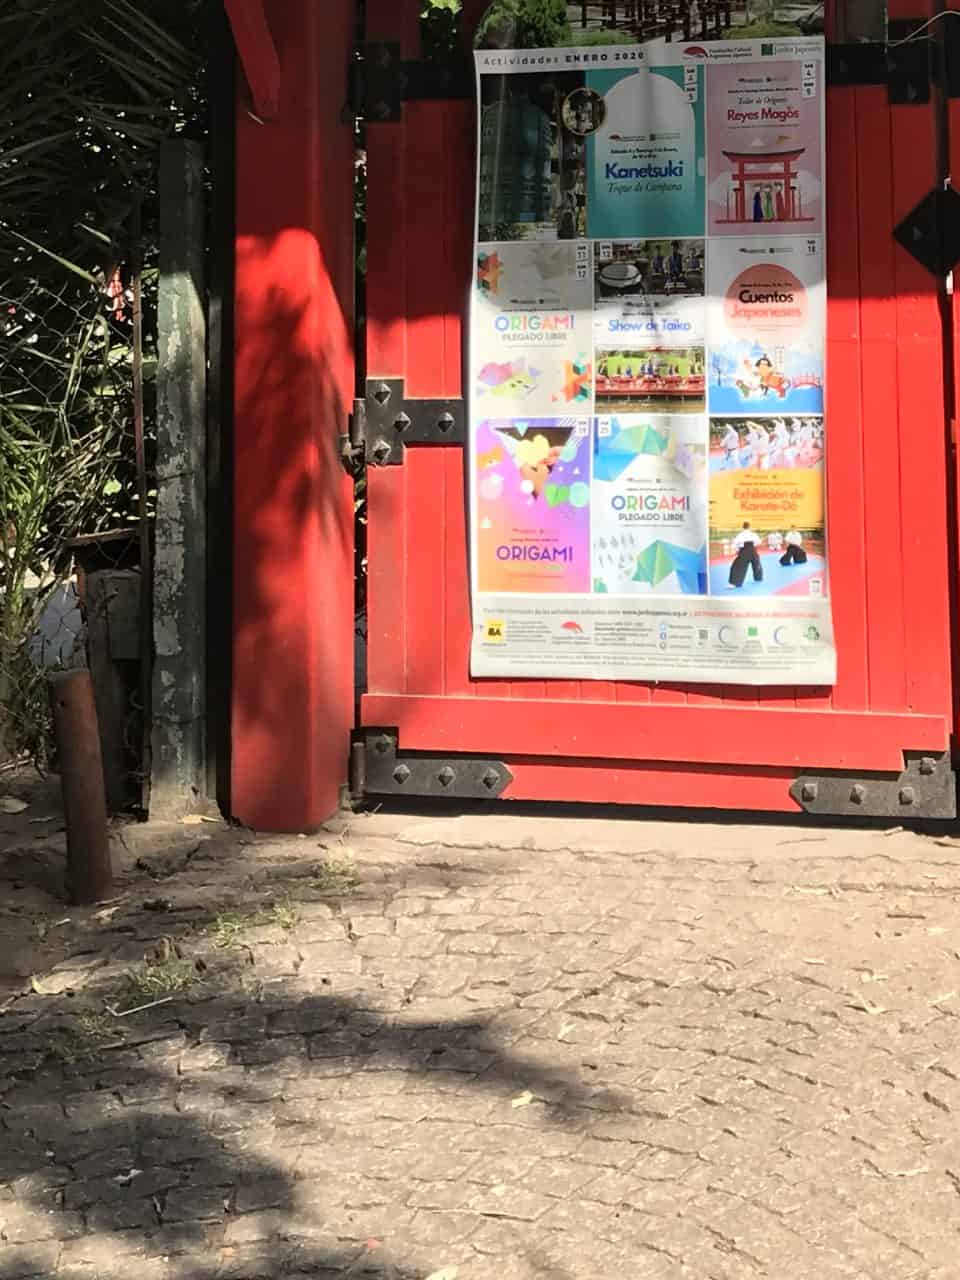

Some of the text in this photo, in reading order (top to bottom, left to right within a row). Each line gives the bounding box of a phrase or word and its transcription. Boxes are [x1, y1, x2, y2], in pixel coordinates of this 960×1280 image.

[484, 51, 645, 66] Actividades ENERO 2020
[728, 107, 800, 122] Reyes Magos
[605, 160, 683, 179] Kanetsuki
[738, 289, 793, 303] Cuentos
[495, 315, 575, 332] ORIGAMI
[609, 320, 642, 331] Show
[663, 320, 690, 330] Taiko
[502, 333, 543, 341] PLEGADO
[611, 494, 690, 511] ORIGAMI
[618, 513, 685, 521] PLEGADO LIBRE
[496, 545, 573, 562] ORIGAMI
